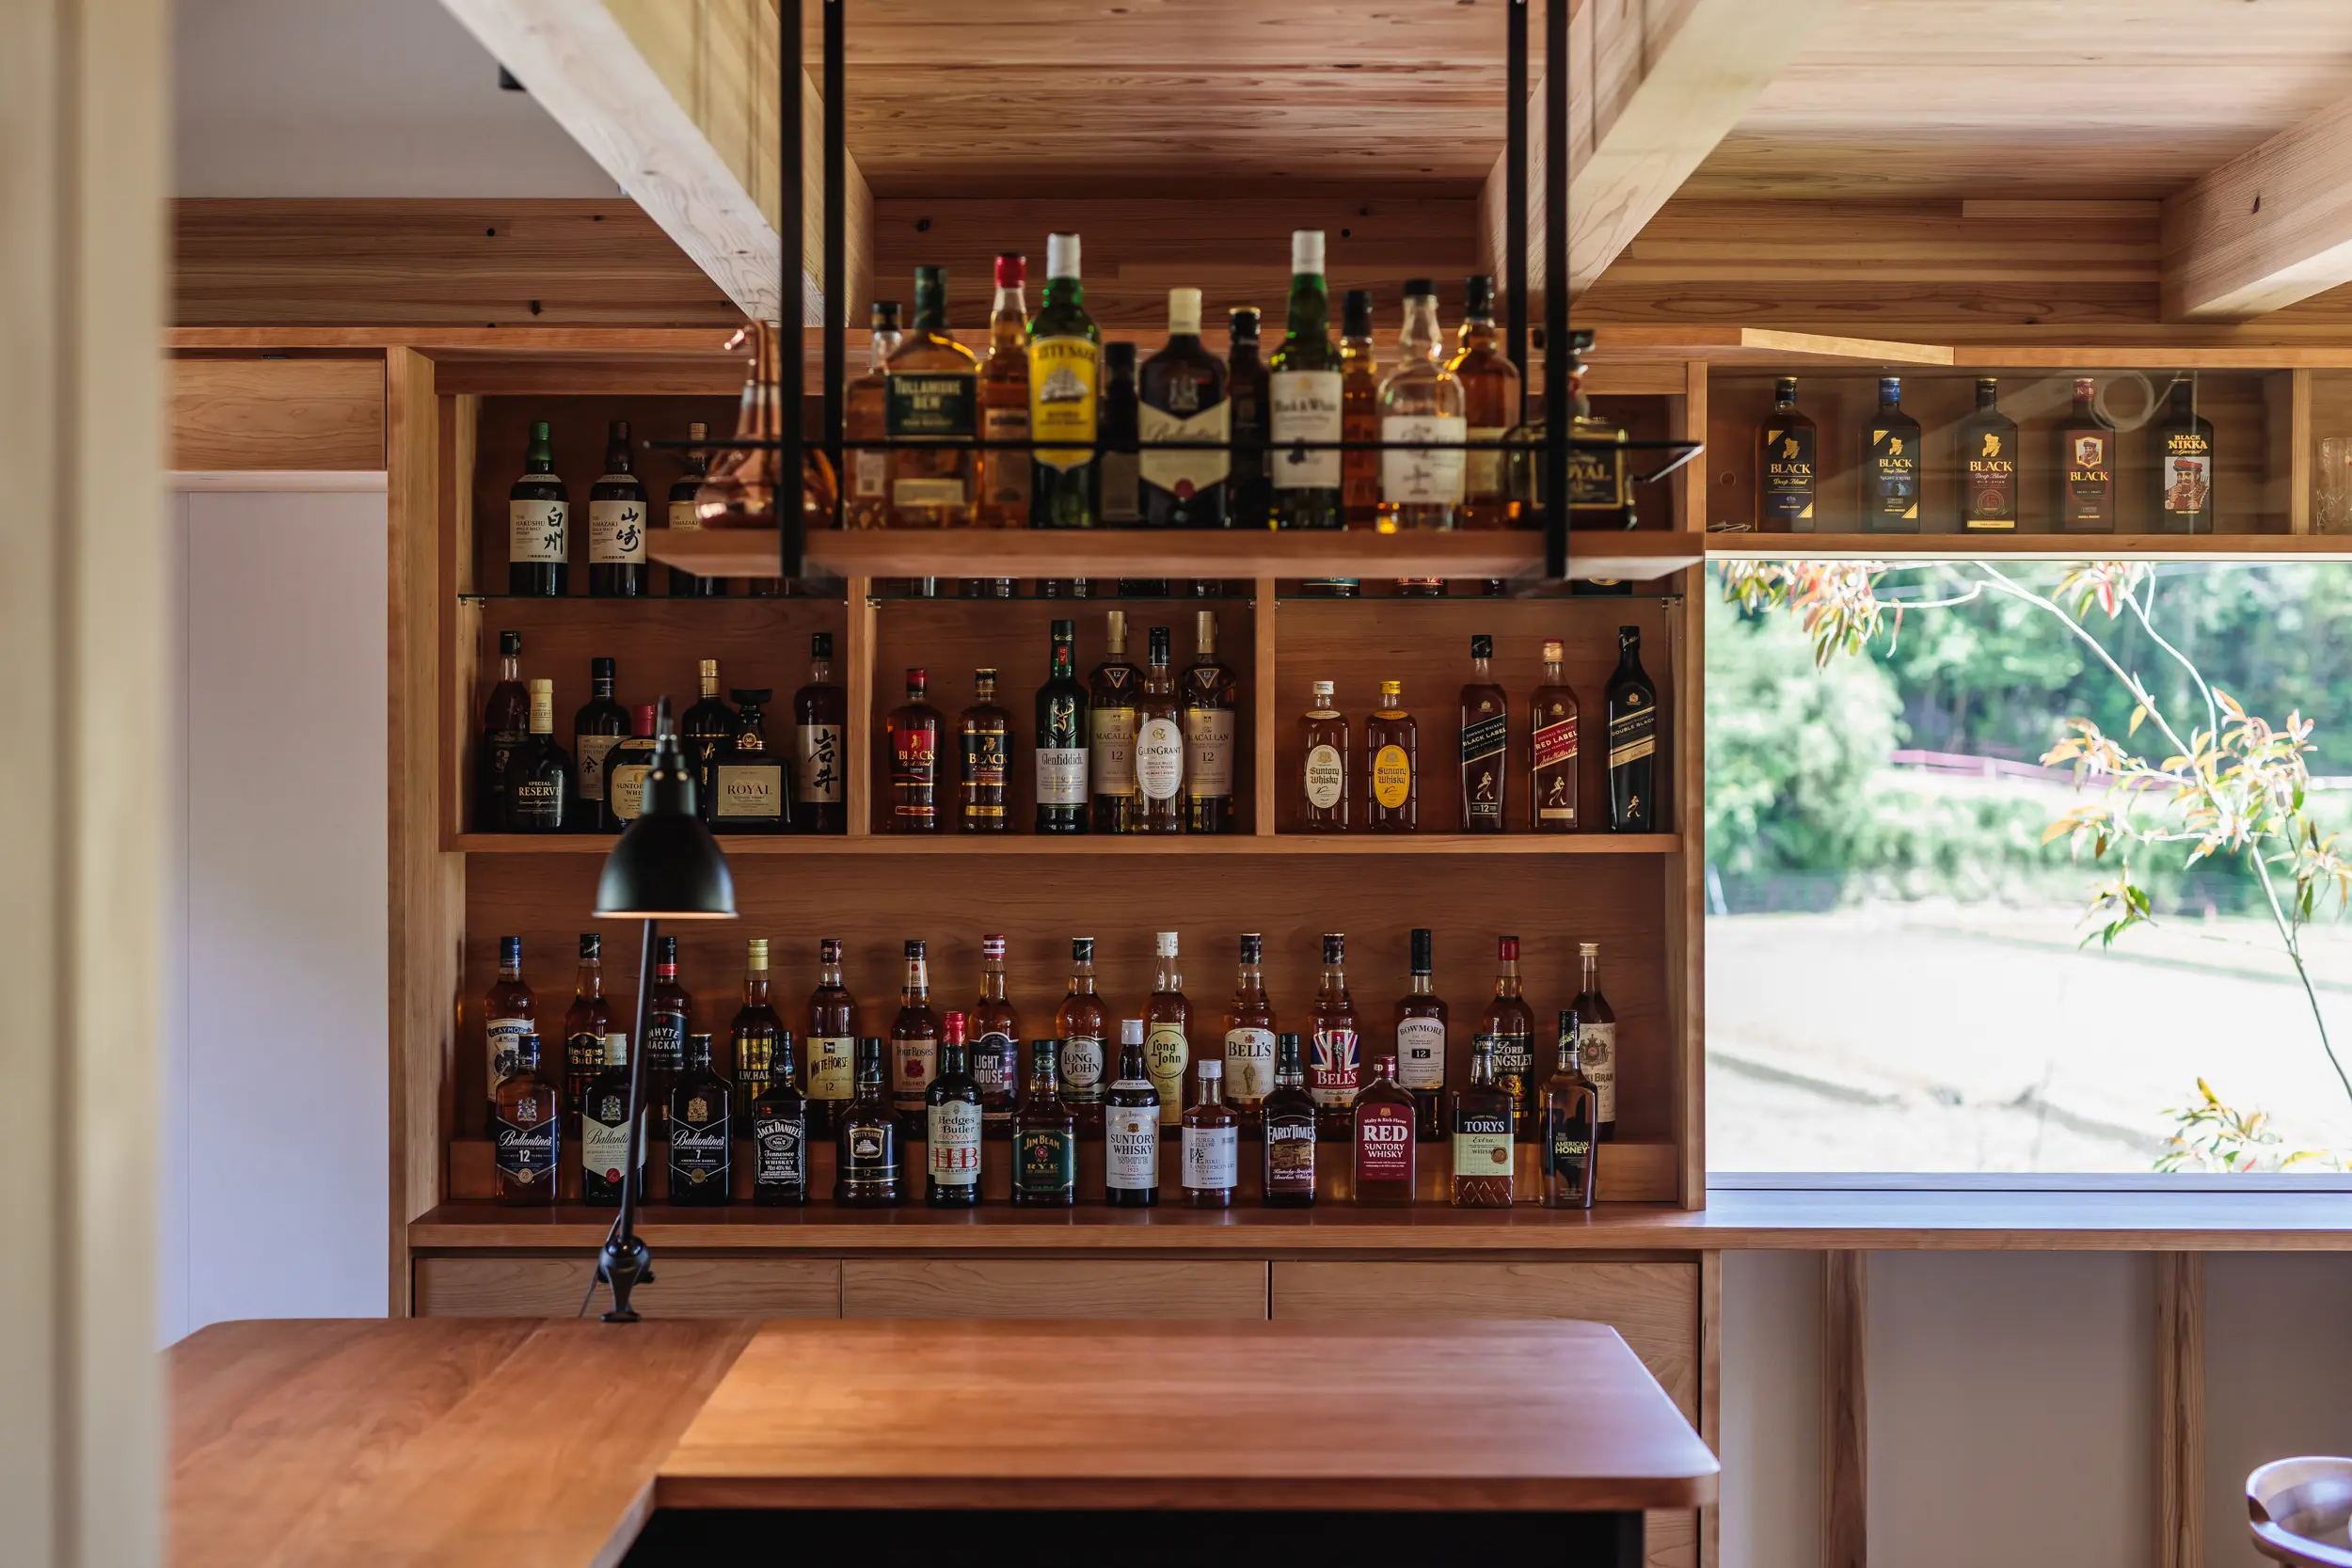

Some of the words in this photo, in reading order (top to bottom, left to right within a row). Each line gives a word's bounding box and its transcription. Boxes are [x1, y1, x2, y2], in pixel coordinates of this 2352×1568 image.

[2168, 440, 2208, 450] NIKKA
[1771, 464, 1811, 473] BLACK
[1879, 459, 1913, 467] BLACK
[1970, 461, 2012, 471] BLACK
[1566, 464, 1612, 481] YAL
[2070, 472, 2108, 481] BLACK
[544, 506, 564, 554] 白州
[616, 507, 641, 552] 山崎
[1612, 724, 1634, 736] DOUBLE
[1636, 718, 1655, 727] BLACK
[1462, 736, 1485, 747] BLACK
[1486, 728, 1506, 737] LABEL
[1535, 740, 1551, 750] RED
[1553, 730, 1577, 743] LABEL
[808, 729, 838, 794] 岩井
[1041, 753, 1083, 765] Glenfiddich
[1111, 751, 1123, 760] 12
[1202, 752, 1215, 762] 12
[1310, 767, 1340, 776] Suntory
[1377, 767, 1406, 776] Suntory
[1310, 776, 1338, 784] Whisky
[1378, 776, 1406, 784] Whisky
[519, 787, 562, 797] RESERVE
[727, 784, 772, 794] ROYAL
[1400, 1025, 1443, 1036] BOWMORE
[568, 1047, 602, 1056] Hedges
[897, 1046, 912, 1056] Four
[913, 1046, 933, 1056] Roses
[1151, 1039, 1176, 1056] Long
[1229, 1041, 1271, 1057] BELL'S
[572, 1056, 603, 1065] Butler
[974, 1055, 1000, 1069] LIGHT
[1064, 1052, 1092, 1065] LONG
[1155, 1052, 1181, 1068] John
[1493, 1054, 1533, 1067] INGSLEY
[811, 1058, 828, 1080] WHITE
[828, 1056, 849, 1070] HORSE
[1067, 1063, 1101, 1075] JOHN
[974, 1069, 1003, 1083] HOUSE
[1317, 1070, 1357, 1085] BELL'S
[1595, 1073, 1613, 1083] BRAN
[825, 1083, 834, 1091] 12
[938, 1117, 975, 1126] Hedges
[1465, 1121, 1504, 1132] TORYS
[757, 1124, 774, 1139] JACK
[944, 1125, 975, 1133] Butler
[1267, 1126, 1292, 1144] EARLY
[1289, 1124, 1316, 1143] TIMES
[1363, 1125, 1407, 1141] RED
[499, 1130, 552, 1147] Ballantine's
[587, 1129, 629, 1145] Ballanti
[672, 1129, 724, 1147] Ballantine's
[1025, 1138, 1039, 1150] JIM
[1039, 1134, 1060, 1150] BEAM
[1110, 1133, 1156, 1145] SUNTORY
[696, 1149, 701, 1159] 7
[1113, 1145, 1152, 1154] WHISKY
[518, 1149, 530, 1163] 12
[934, 1147, 953, 1168] H
[960, 1147, 977, 1168] B
[1190, 1148, 1204, 1164] 陸
